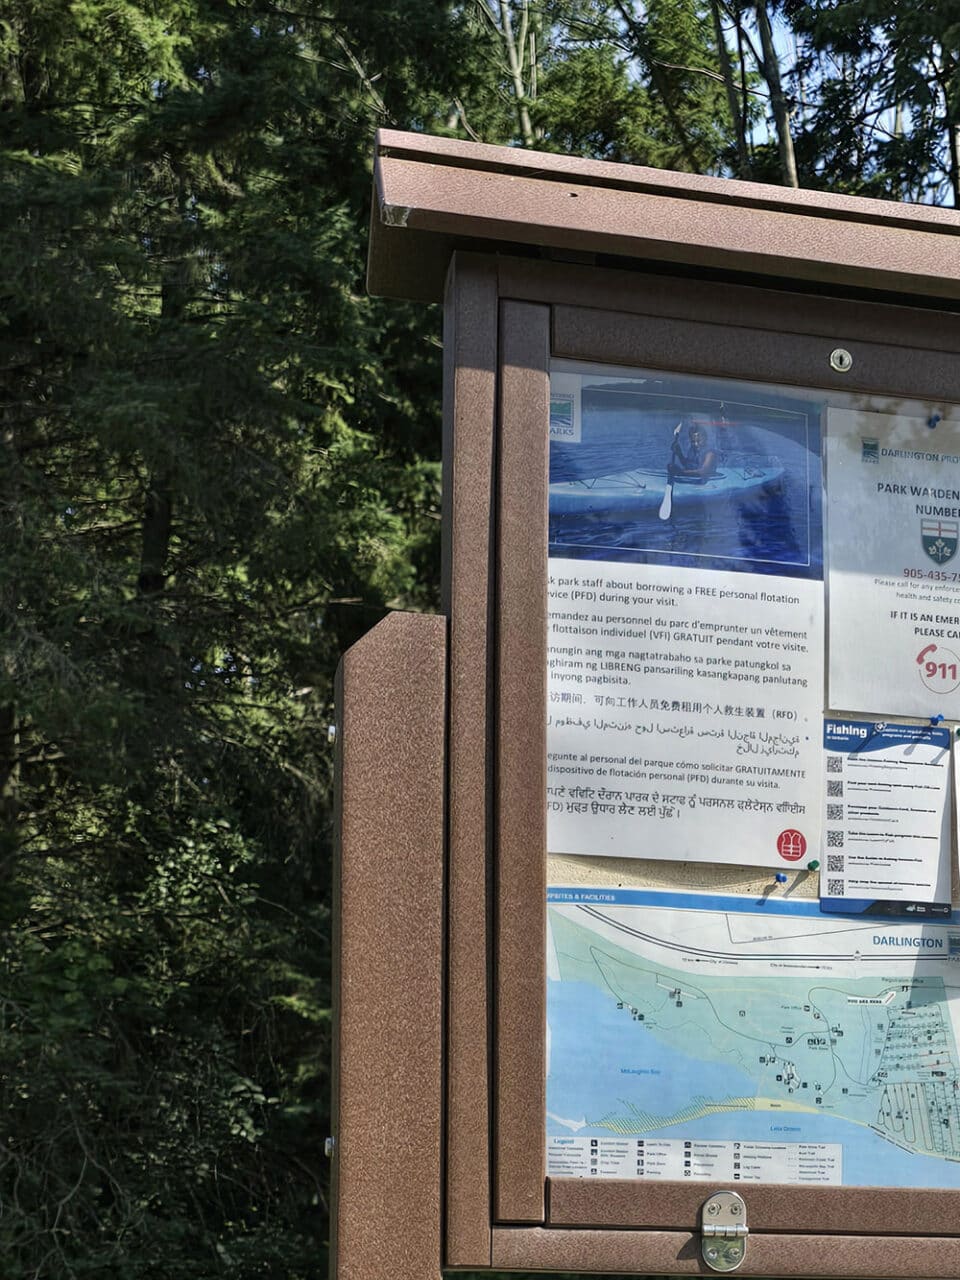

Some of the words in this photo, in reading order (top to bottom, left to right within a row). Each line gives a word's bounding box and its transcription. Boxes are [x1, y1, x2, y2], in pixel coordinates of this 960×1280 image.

[881, 448, 939, 461] DARLINGTON
[877, 482, 906, 494] PARK
[910, 485, 959, 500] WARDEN
[558, 577, 579, 586] park
[582, 578, 602, 587] staff
[606, 580, 632, 589] about
[636, 582, 684, 595] borrowing
[695, 586, 716, 596] FREE
[719, 590, 757, 599] personal
[760, 592, 799, 603] flotation
[571, 590, 596, 602] (PFD)
[599, 592, 629, 605] during
[656, 597, 678, 605] visit.
[549, 612, 588, 624] mandez
[606, 616, 651, 625] personnel
[655, 618, 666, 626] du
[691, 620, 747, 633] d'emprunter
[910, 613, 918, 621] IS
[920, 614, 932, 622] AN
[552, 624, 598, 635] flottaison
[601, 627, 646, 638] individuel
[650, 630, 670, 641] (VFI)
[673, 632, 713, 642] GRATUIT
[716, 637, 753, 647] pendant
[756, 641, 780, 649] votre
[782, 643, 808, 652] visite.
[914, 627, 944, 637] PLEASE
[925, 661, 956, 680] 911
[826, 724, 867, 738] Fishing
[548, 765, 594, 775] dispositivo
[596, 767, 607, 775] de
[609, 768, 646, 778] flotación
[687, 773, 709, 783] (PFD)
[711, 775, 743, 785] durante
[757, 779, 780, 789] visita.
[873, 936, 942, 951] DARLINGTON
